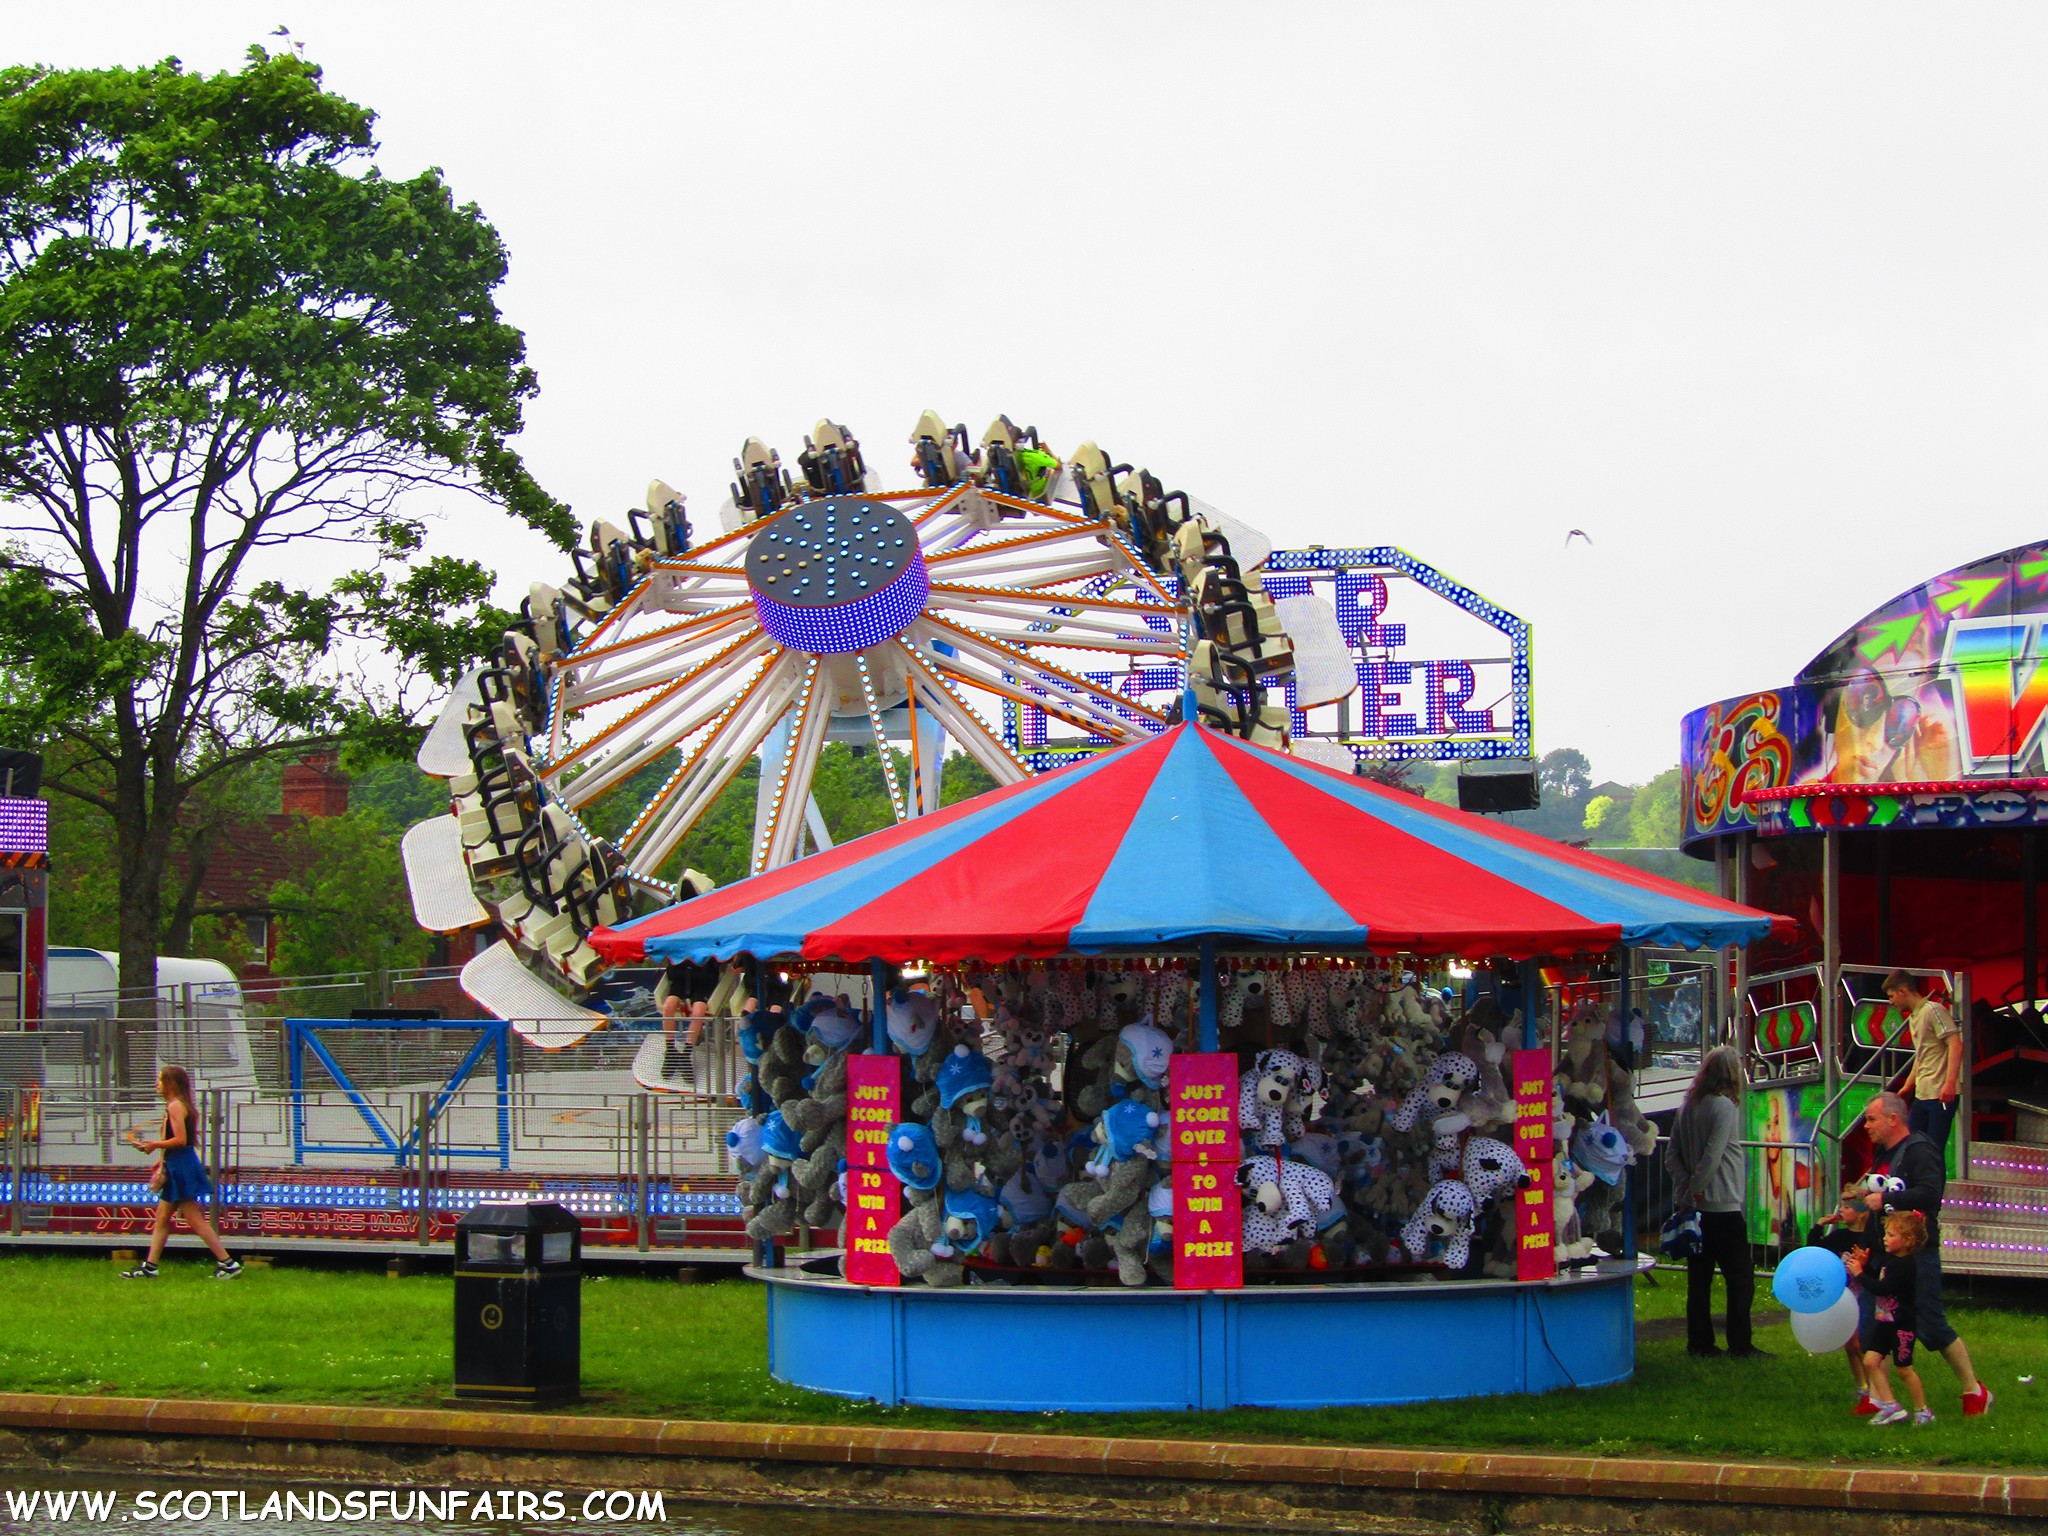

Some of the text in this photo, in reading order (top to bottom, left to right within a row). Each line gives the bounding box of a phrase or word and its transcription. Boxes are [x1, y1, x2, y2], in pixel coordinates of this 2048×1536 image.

[854, 1085, 889, 1101] JUST
[1180, 1085, 1225, 1100] JUST
[1519, 1080, 1544, 1096] JUST
[851, 1107, 893, 1123] SCORE
[1176, 1107, 1230, 1123] SCORE
[1517, 1102, 1547, 1118] SCORE
[853, 1129, 889, 1145] OVER
[1180, 1129, 1226, 1145] OVER
[1519, 1124, 1545, 1139] OVER
[862, 1173, 881, 1188] TO
[1192, 1174, 1217, 1190] TO
[1527, 1168, 1541, 1183] TO
[858, 1194, 885, 1210] WIN
[1187, 1196, 1223, 1213] WIN
[1524, 1190, 1544, 1204] WIN
[308, 1212, 365, 1231] THIS
[866, 1216, 877, 1231] A
[1199, 1219, 1212, 1234] A
[1530, 1212, 1539, 1226] A
[1184, 1241, 1234, 1258] PRIZE
[1523, 1233, 1550, 1250] PRIZE
